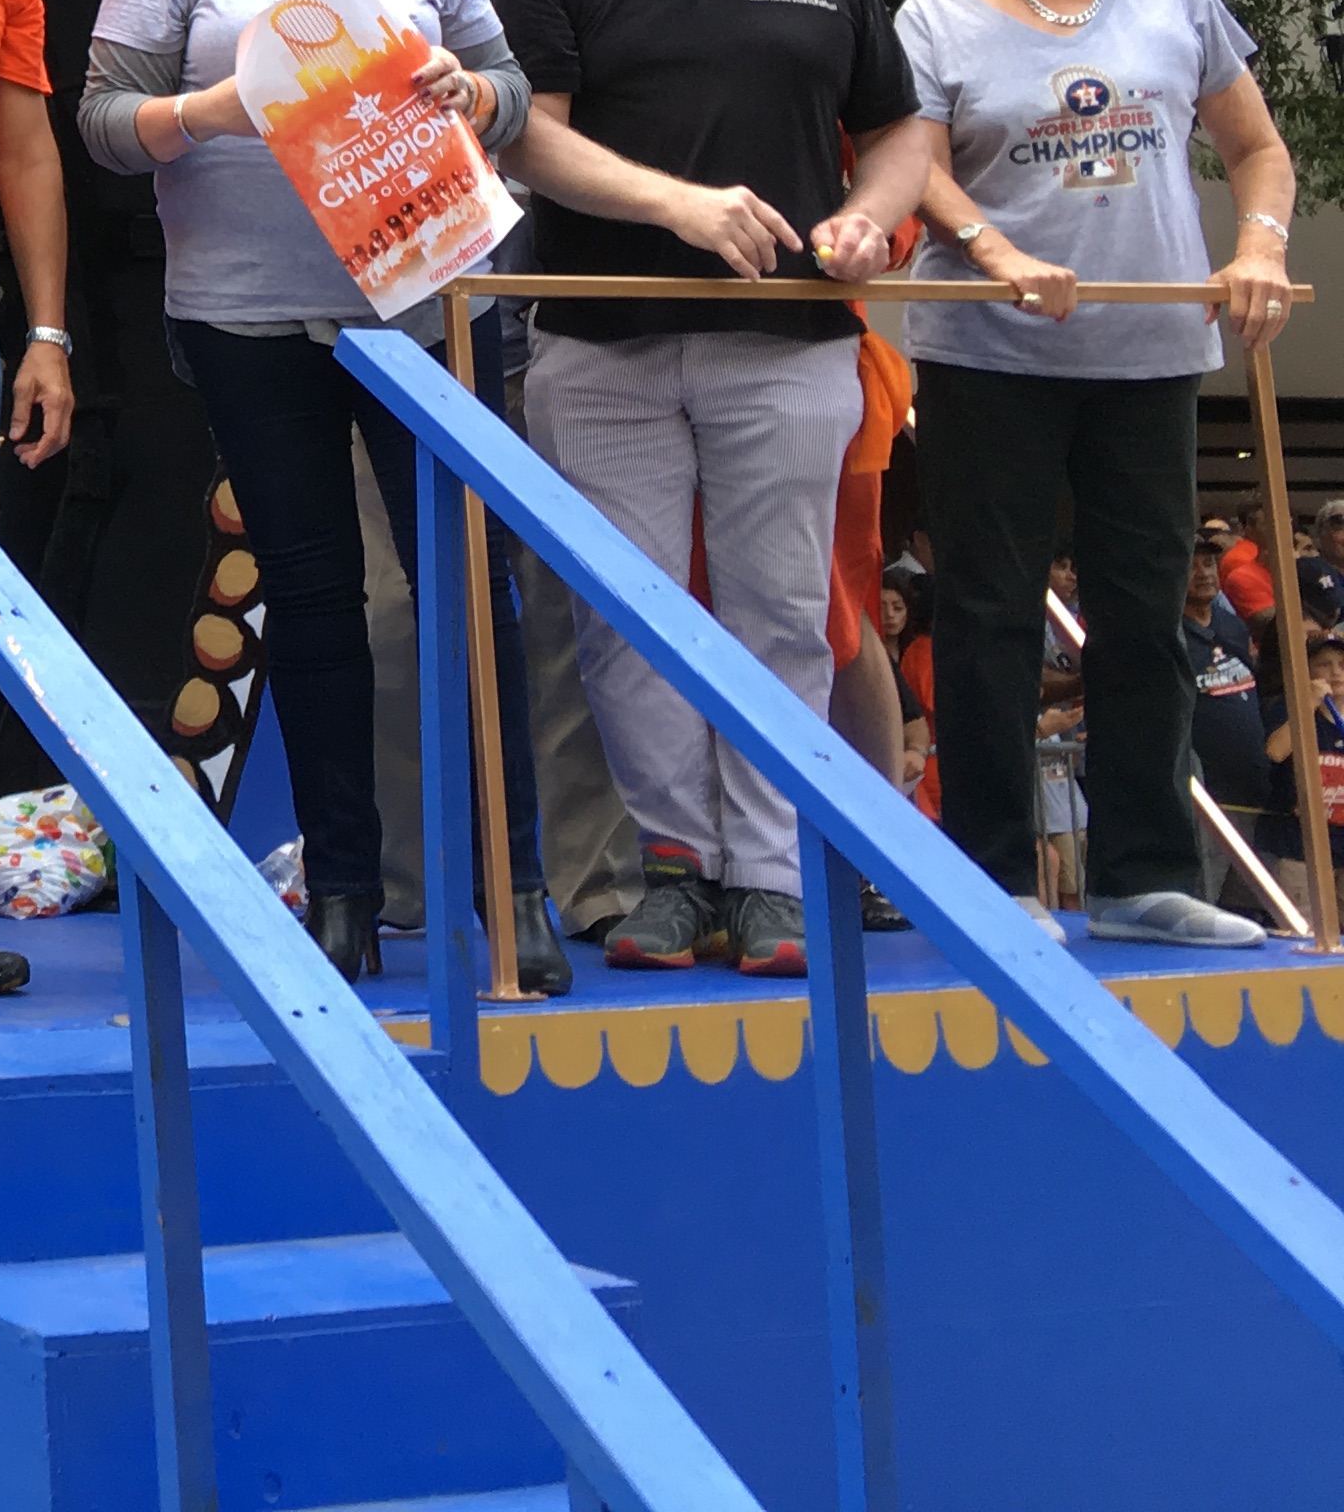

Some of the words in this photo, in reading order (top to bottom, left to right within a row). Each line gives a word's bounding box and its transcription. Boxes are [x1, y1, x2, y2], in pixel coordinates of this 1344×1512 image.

[321, 130, 388, 175] WORLD
[386, 97, 435, 137] SERIES
[1026, 119, 1095, 138] WORLD
[1098, 111, 1154, 129] SERIES
[1008, 127, 1167, 165] CHAMPIONS
